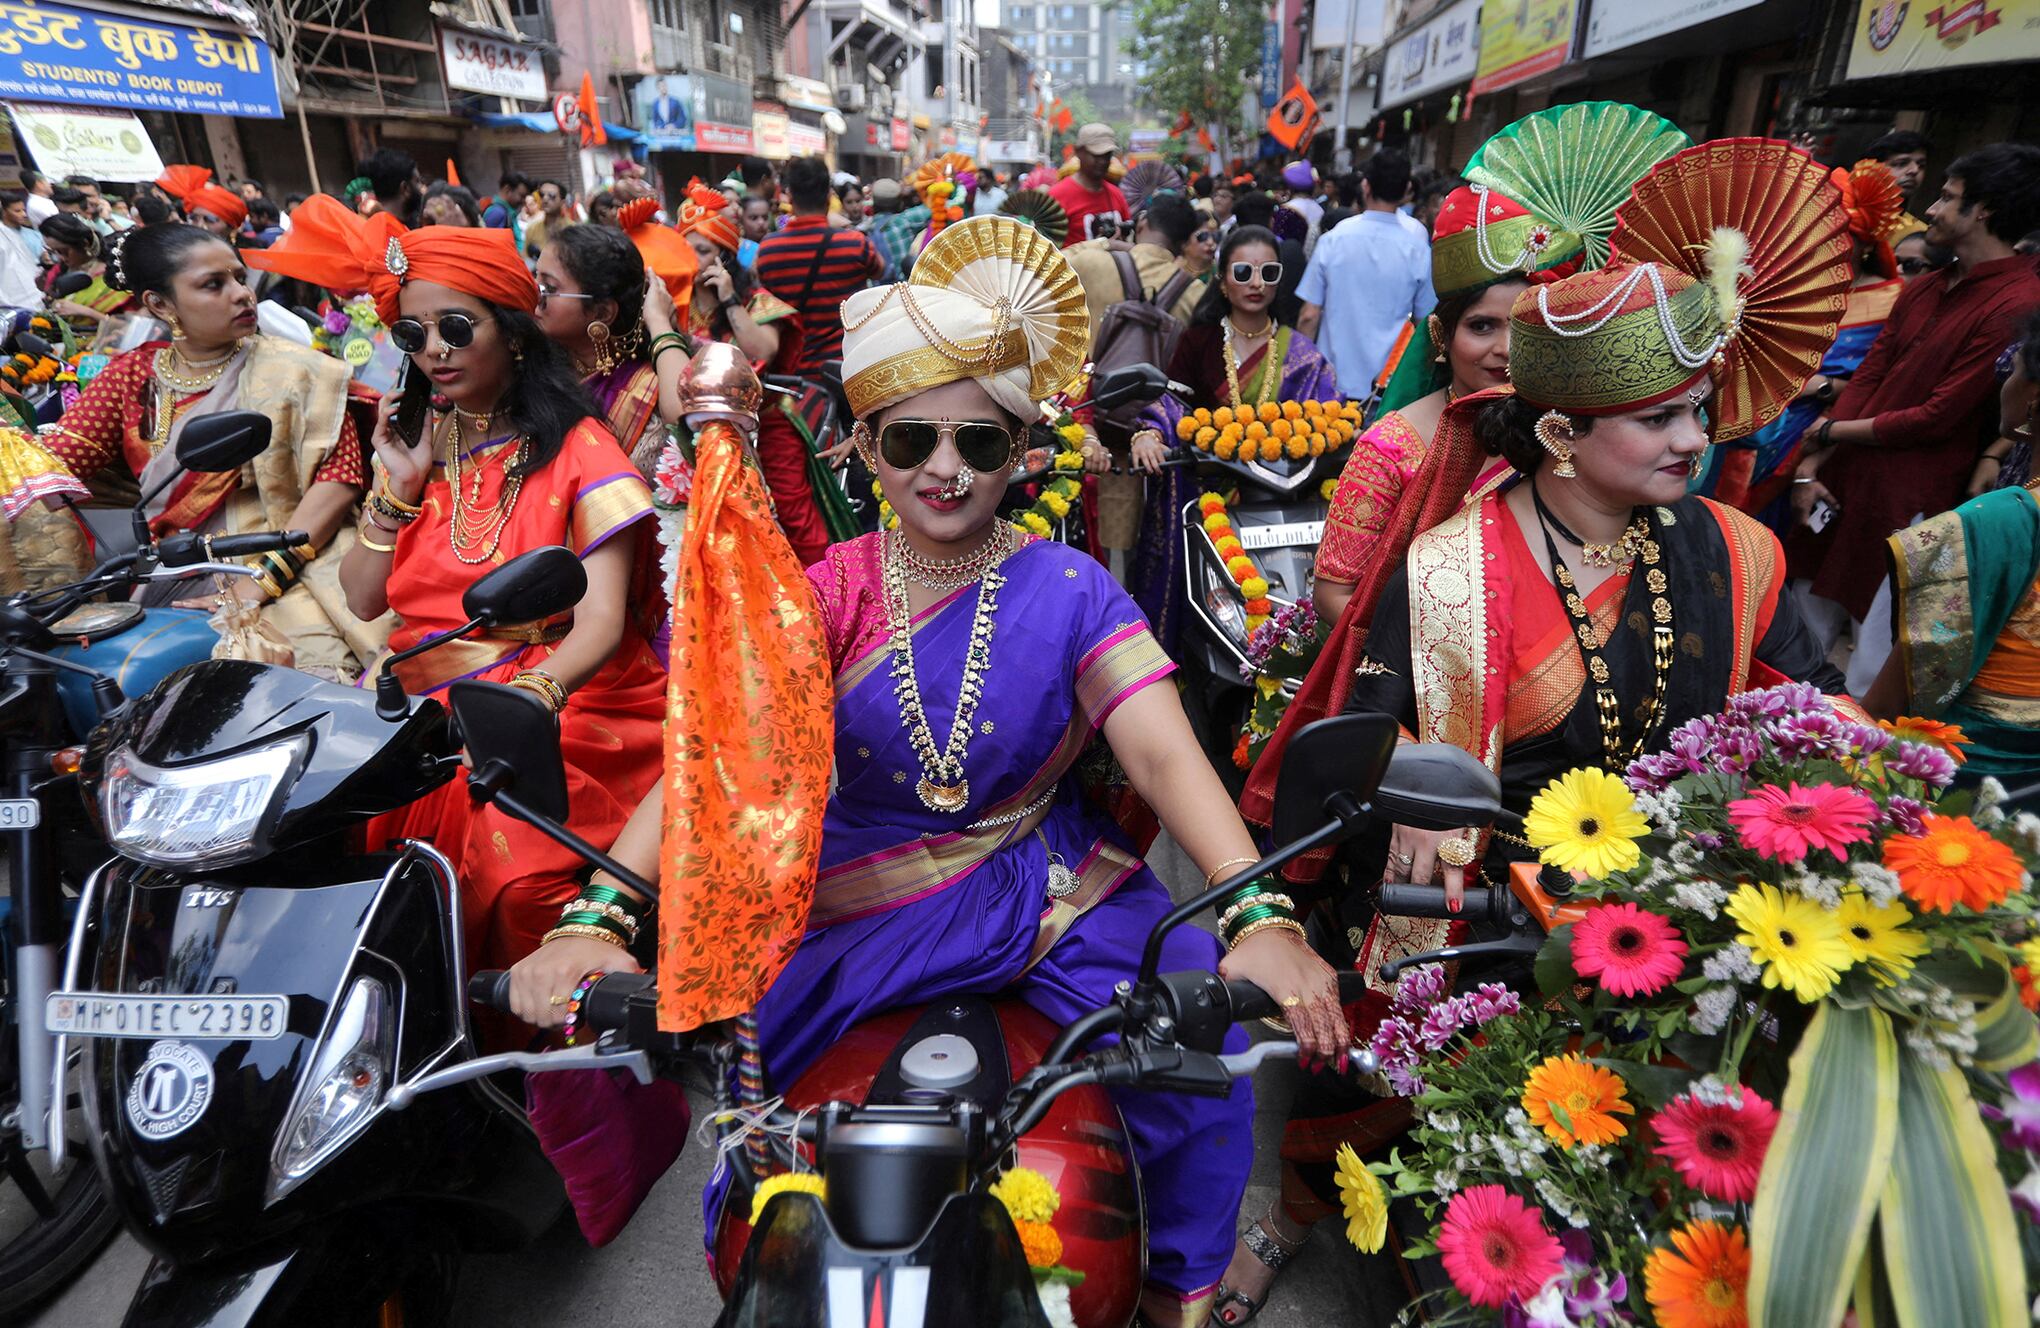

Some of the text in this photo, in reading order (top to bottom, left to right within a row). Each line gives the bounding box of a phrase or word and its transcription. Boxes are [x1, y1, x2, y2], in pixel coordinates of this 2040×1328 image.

[94, 18, 178, 70] बुक
[455, 36, 529, 72] SAGAR
[21, 61, 223, 96] STUDENTS' BOOK DEPOT
[346, 351, 370, 360] ROAD
[350, 343, 366, 352] OFF
[186, 890, 234, 908] TVS
[74, 1001, 275, 1032] MH 01EC 2398
[148, 1045, 203, 1072] DVOCATE
[148, 1119, 178, 1133] HIGH
[178, 1082, 208, 1124] COURT
